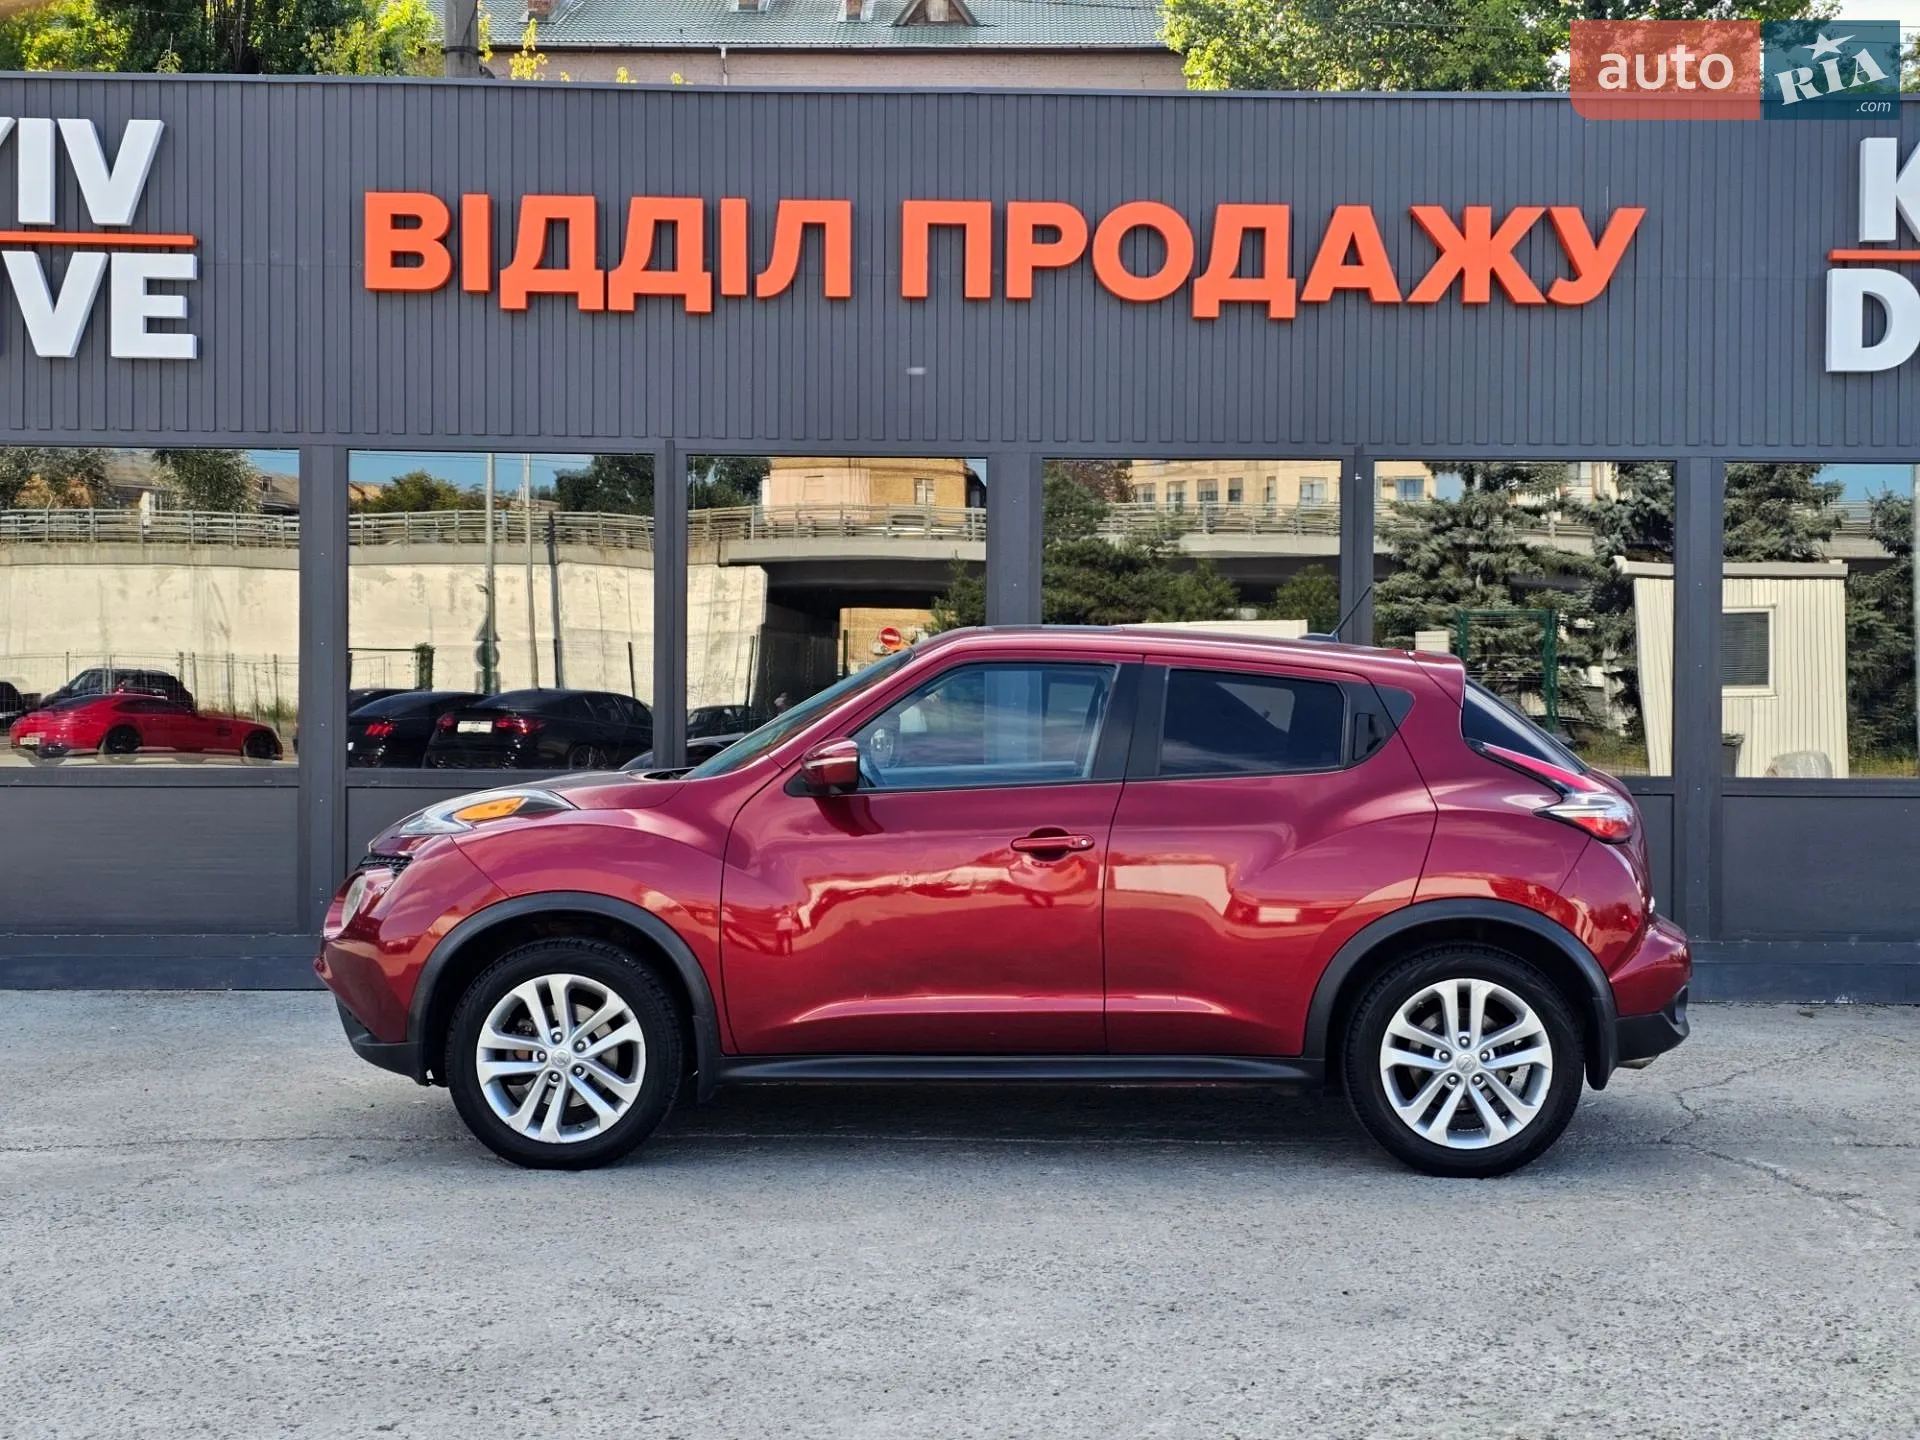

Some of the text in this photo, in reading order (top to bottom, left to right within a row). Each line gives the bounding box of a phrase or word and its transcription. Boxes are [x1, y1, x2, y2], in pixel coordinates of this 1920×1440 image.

[2, 250, 198, 359] VE
[365, 191, 1647, 319] ВІДДІЛ ПРОДАЖУ
